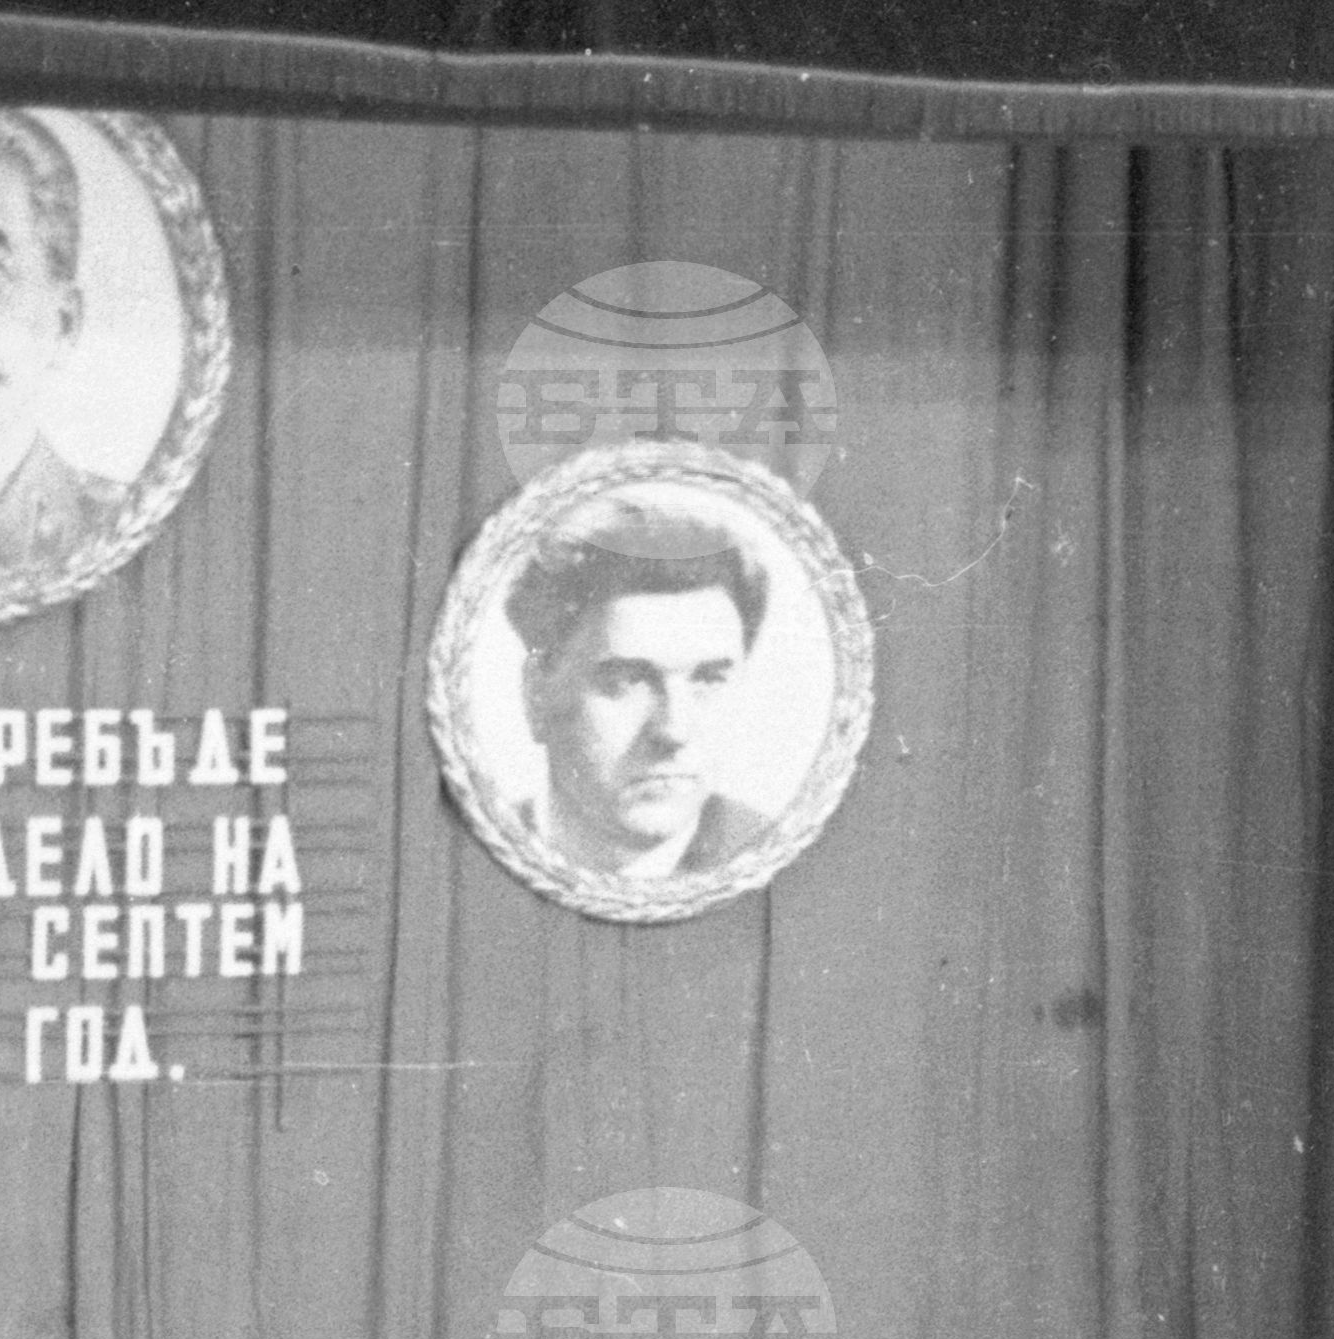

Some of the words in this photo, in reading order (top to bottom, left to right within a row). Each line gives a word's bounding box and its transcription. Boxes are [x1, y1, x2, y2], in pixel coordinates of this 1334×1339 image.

[212, 814, 302, 895] НА
[30, 901, 304, 981] СЕПТЕМ
[24, 1004, 186, 1084] ГОД.
